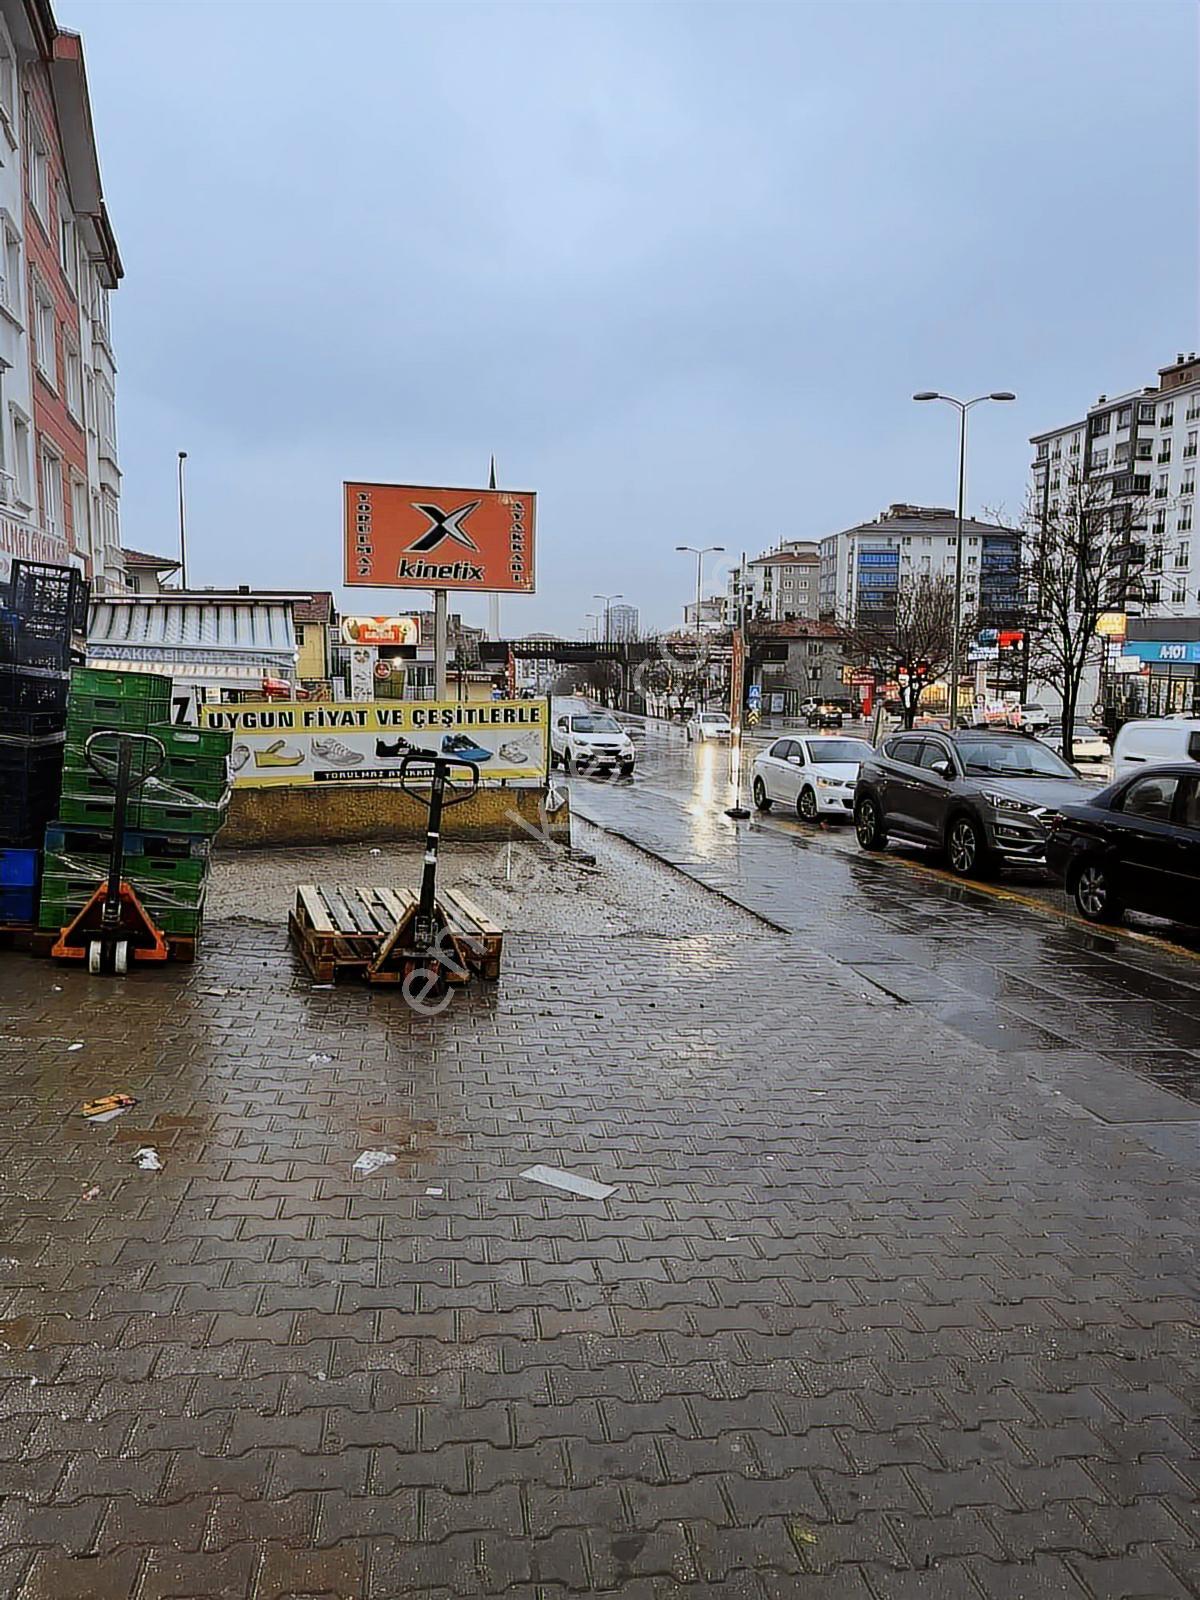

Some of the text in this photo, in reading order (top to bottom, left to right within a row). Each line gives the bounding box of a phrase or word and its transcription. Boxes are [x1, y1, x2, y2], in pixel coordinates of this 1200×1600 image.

[510, 500, 526, 583] AYAKKABI
[399, 558, 485, 582] kinetix
[208, 705, 540, 729] UYGUN FİYAT VE ÇEŞİTLERLE
